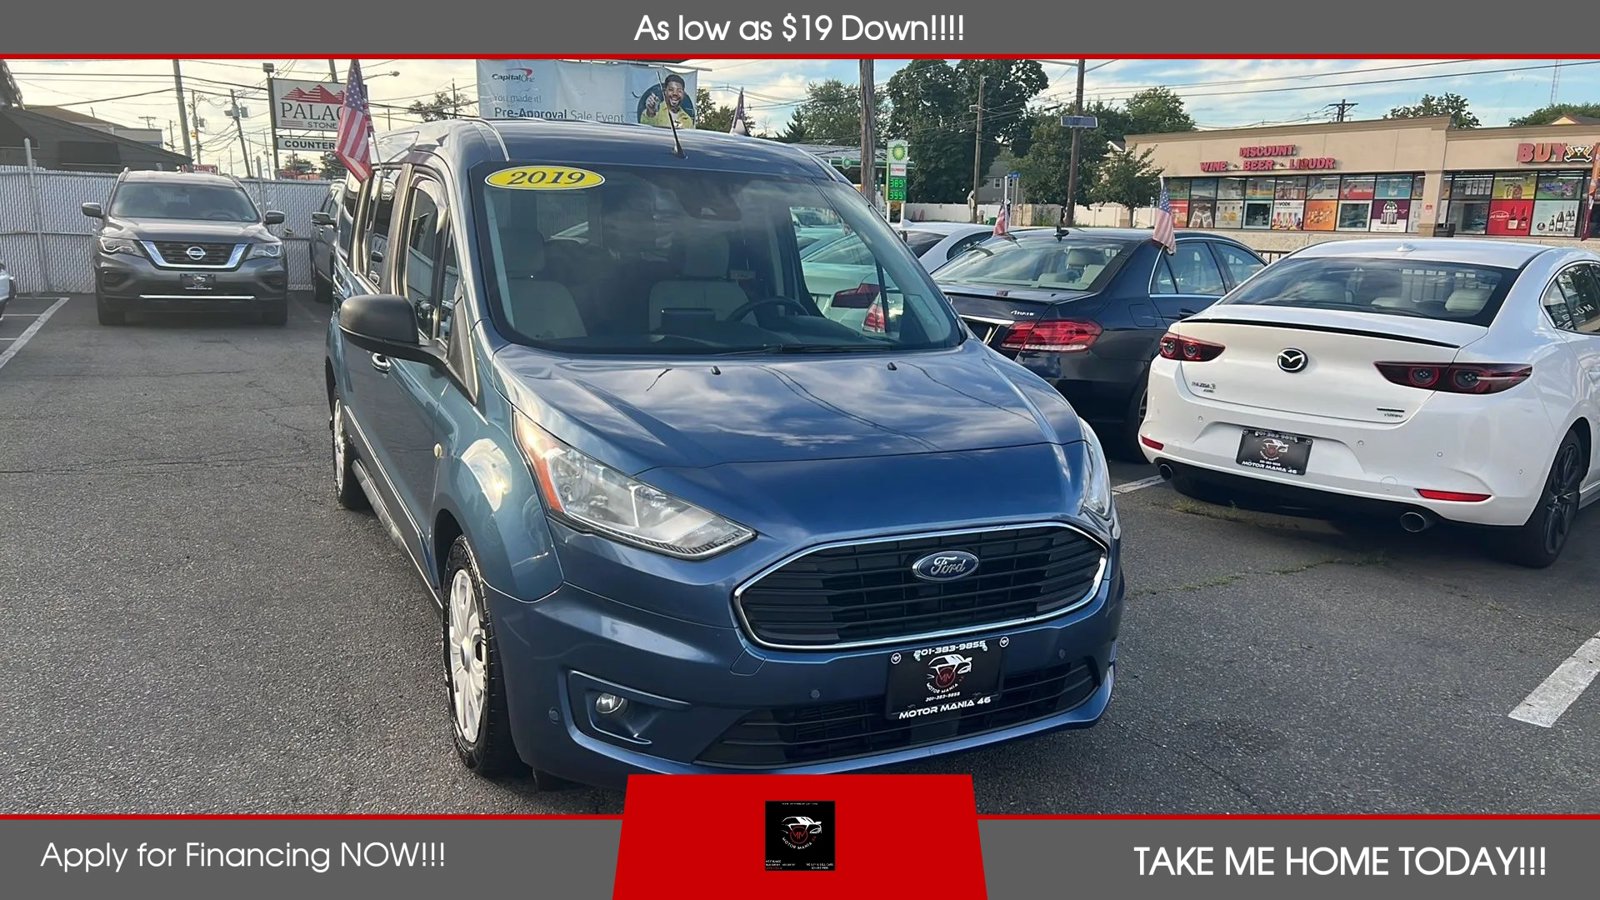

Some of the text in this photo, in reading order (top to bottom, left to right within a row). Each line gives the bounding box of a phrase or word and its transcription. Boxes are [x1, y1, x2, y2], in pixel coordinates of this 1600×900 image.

[494, 106, 625, 123] Pre-Approval Sale Event
[1240, 145, 1296, 157] DISCOUNT
[1518, 143, 1568, 162] BUY
[1200, 158, 1336, 172] WINE BEER LIQUOR
[507, 170, 586, 185] 2019
[930, 556, 966, 575] Ford
[899, 696, 992, 720] MOTOR MANIA 46
